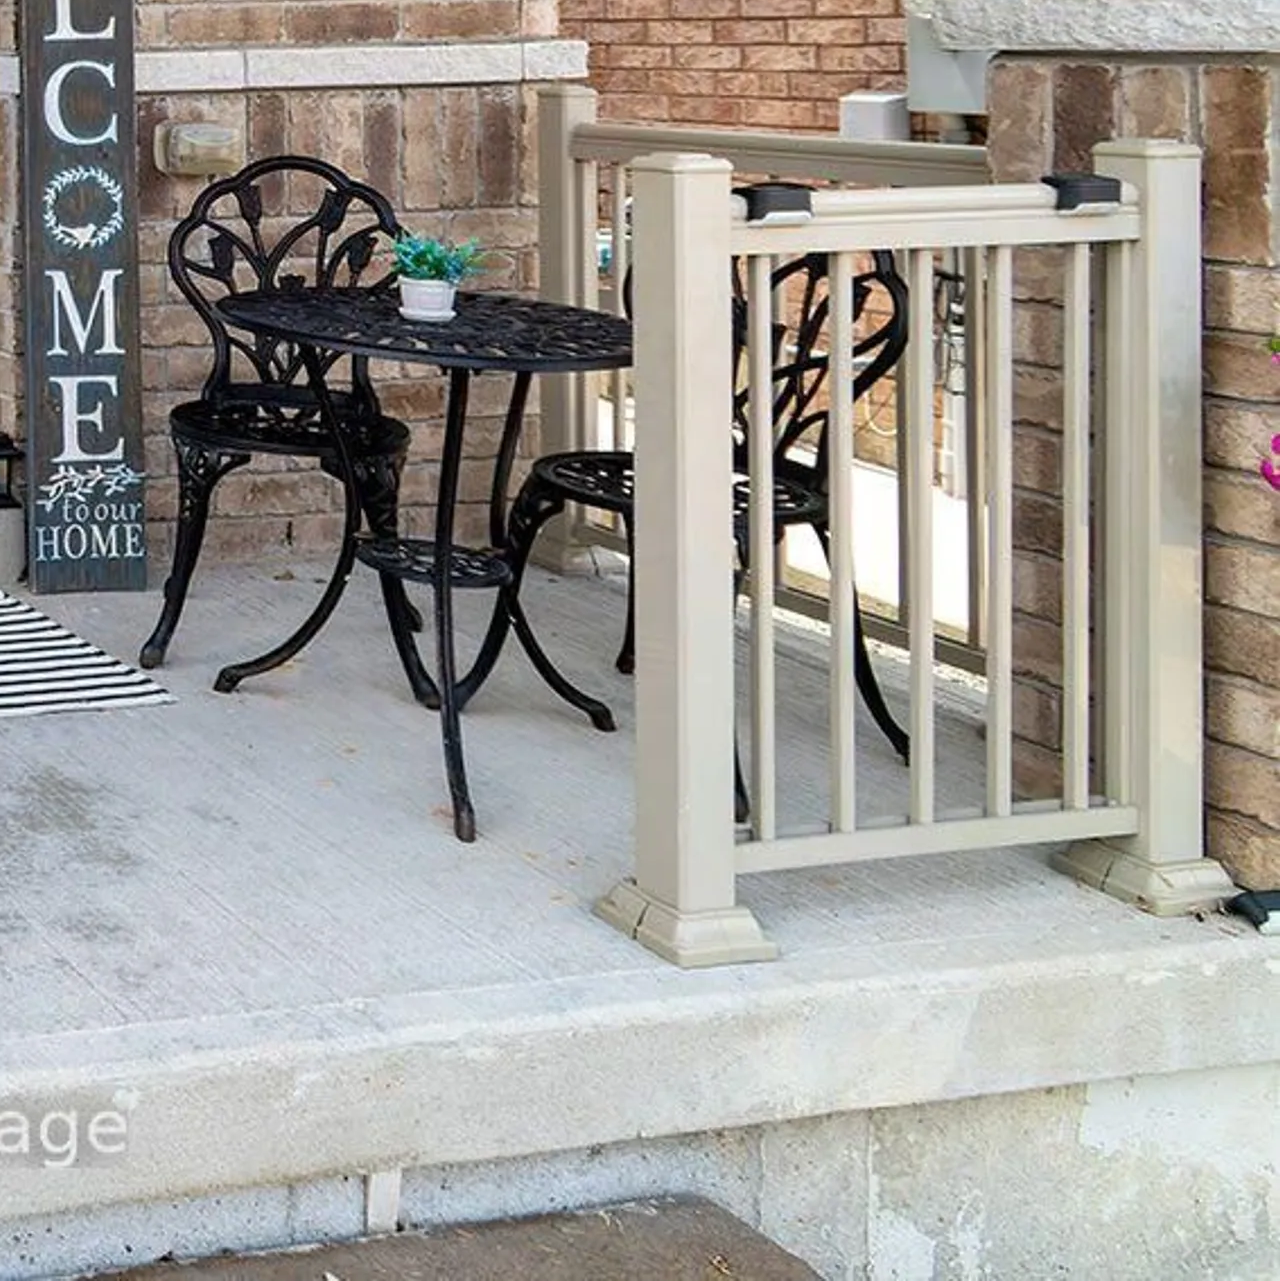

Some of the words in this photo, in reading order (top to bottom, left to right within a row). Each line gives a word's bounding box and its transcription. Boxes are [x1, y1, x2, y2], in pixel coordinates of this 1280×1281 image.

[63, 497, 90, 522] to
[94, 503, 142, 522] our
[35, 523, 145, 561] HOME
